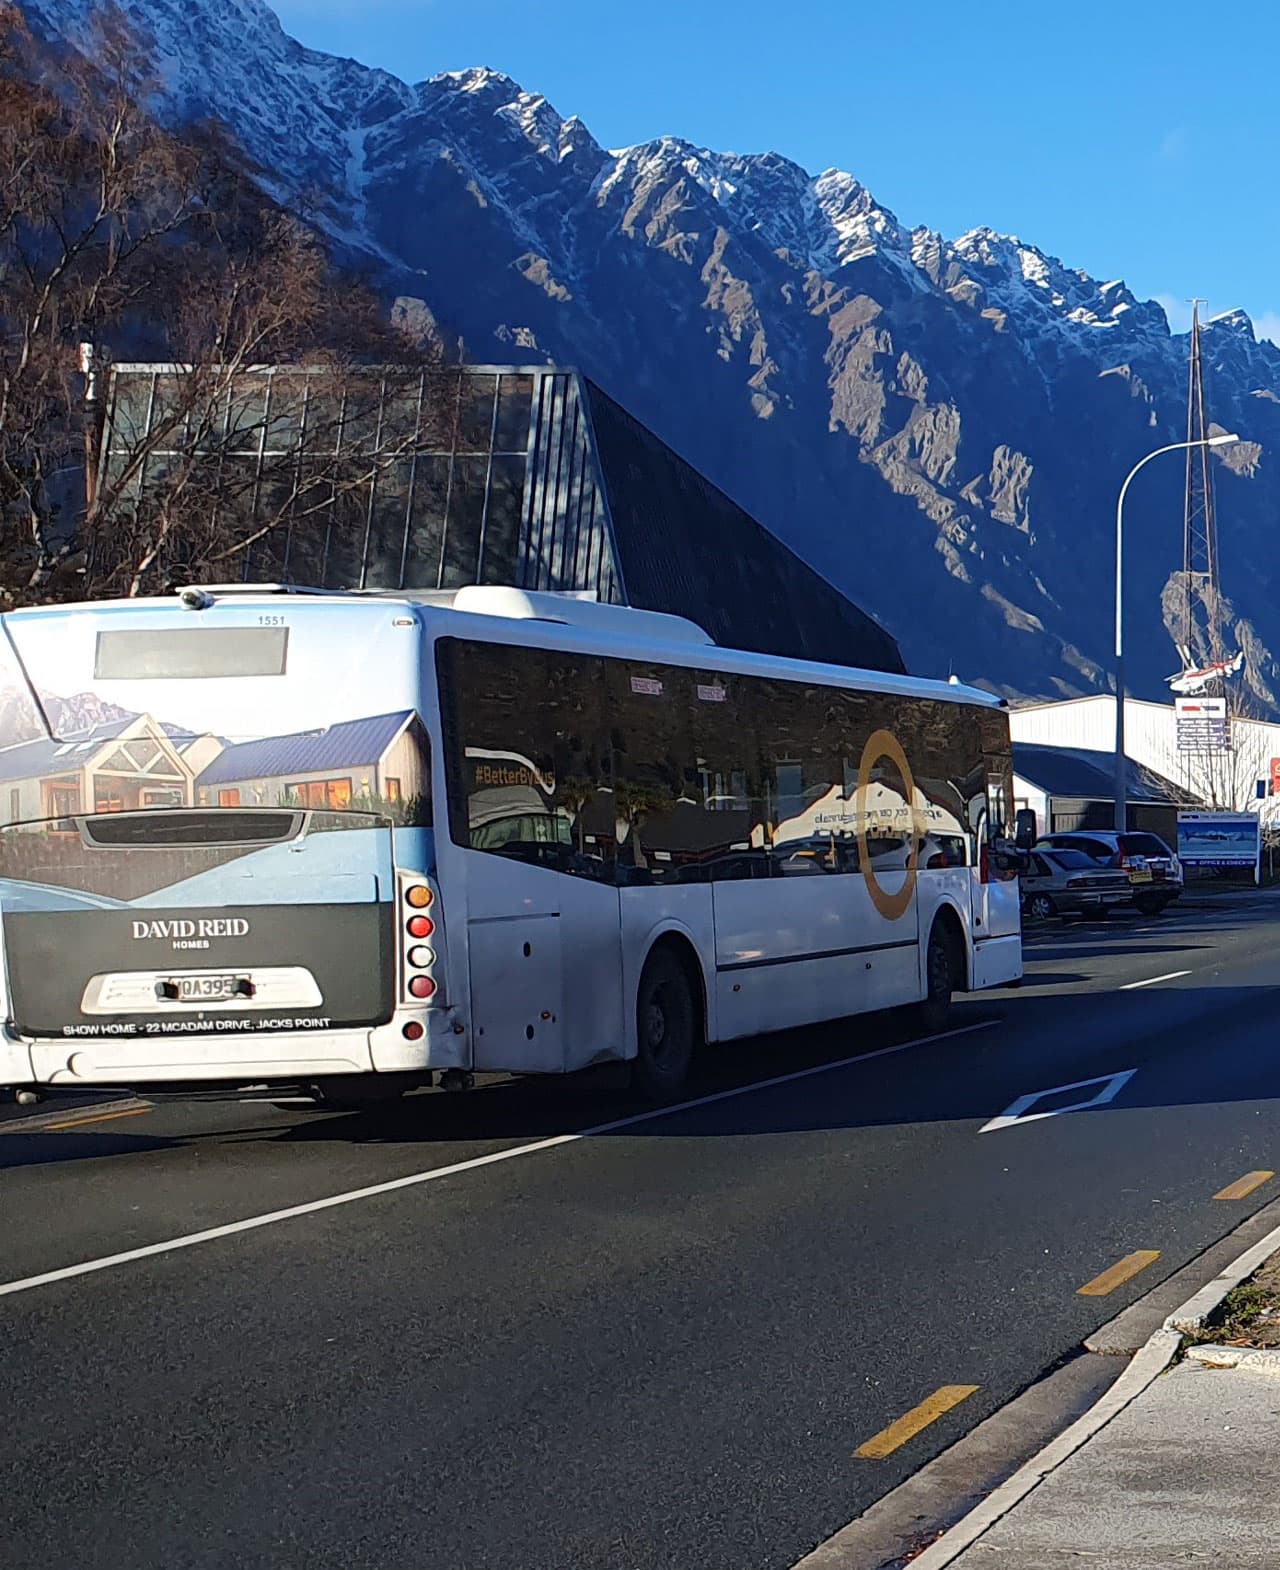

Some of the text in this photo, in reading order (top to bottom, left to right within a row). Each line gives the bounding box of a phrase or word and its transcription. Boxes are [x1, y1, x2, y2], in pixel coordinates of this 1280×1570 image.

[258, 615, 285, 625] 1551
[132, 918, 249, 939] DAVID REID
[172, 940, 210, 949] HOMES
[176, 979, 233, 996] QA395
[63, 1024, 99, 1035] SHOW
[101, 1023, 137, 1034] HOME
[146, 1022, 161, 1033] 22
[161, 1020, 214, 1032] MCADAM
[215, 1019, 255, 1031] DRIVE,
[256, 1018, 294, 1029] JACKS
[295, 1018, 331, 1028] POINT
